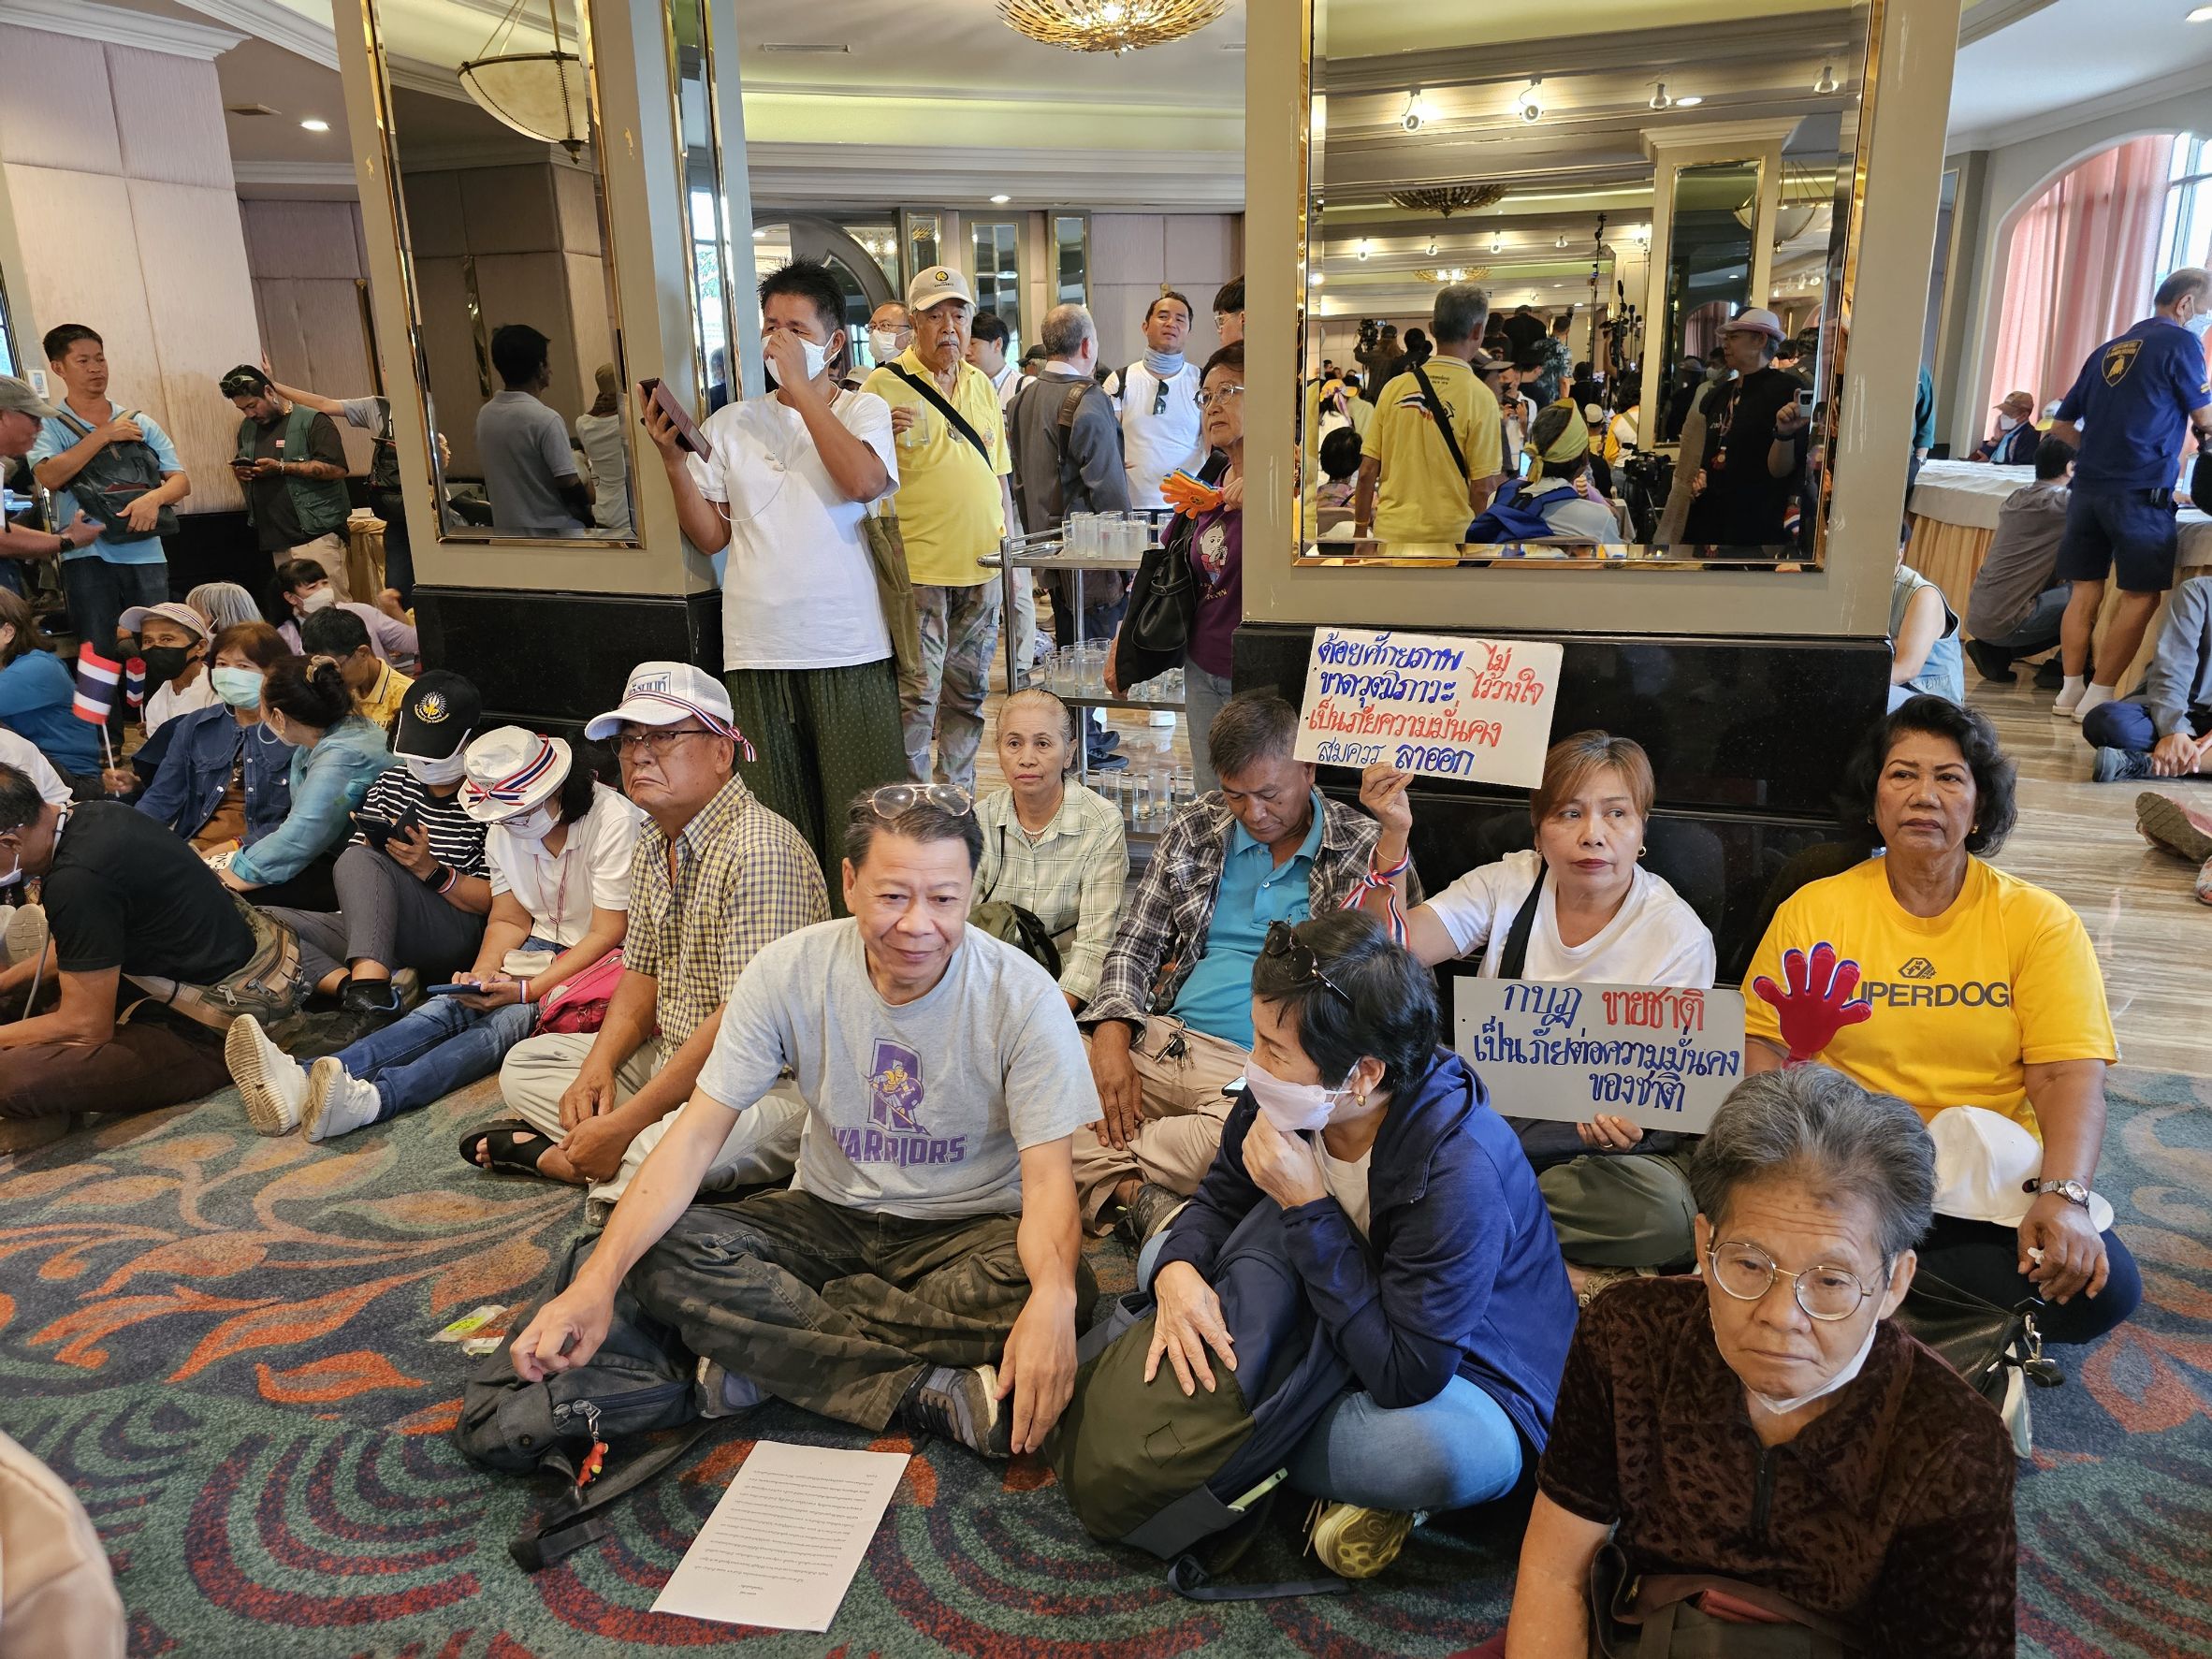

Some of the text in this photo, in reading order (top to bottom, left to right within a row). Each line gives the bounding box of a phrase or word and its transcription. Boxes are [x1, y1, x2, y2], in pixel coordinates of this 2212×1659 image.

[1317, 631, 1513, 672] ด้อยศักยภาพ ไม่
[1466, 667, 1544, 706] ไว้วางใจ
[1308, 695, 1503, 748] เป็นภัยความมั่นคง
[1317, 736, 1476, 776] สมควร ลาออก
[1602, 986, 1704, 1031] ขายชาติ
[1474, 1016, 1740, 1077] เป็นภัยต่อความมั่นคง
[1589, 1070, 1685, 1112] ของชาติ
